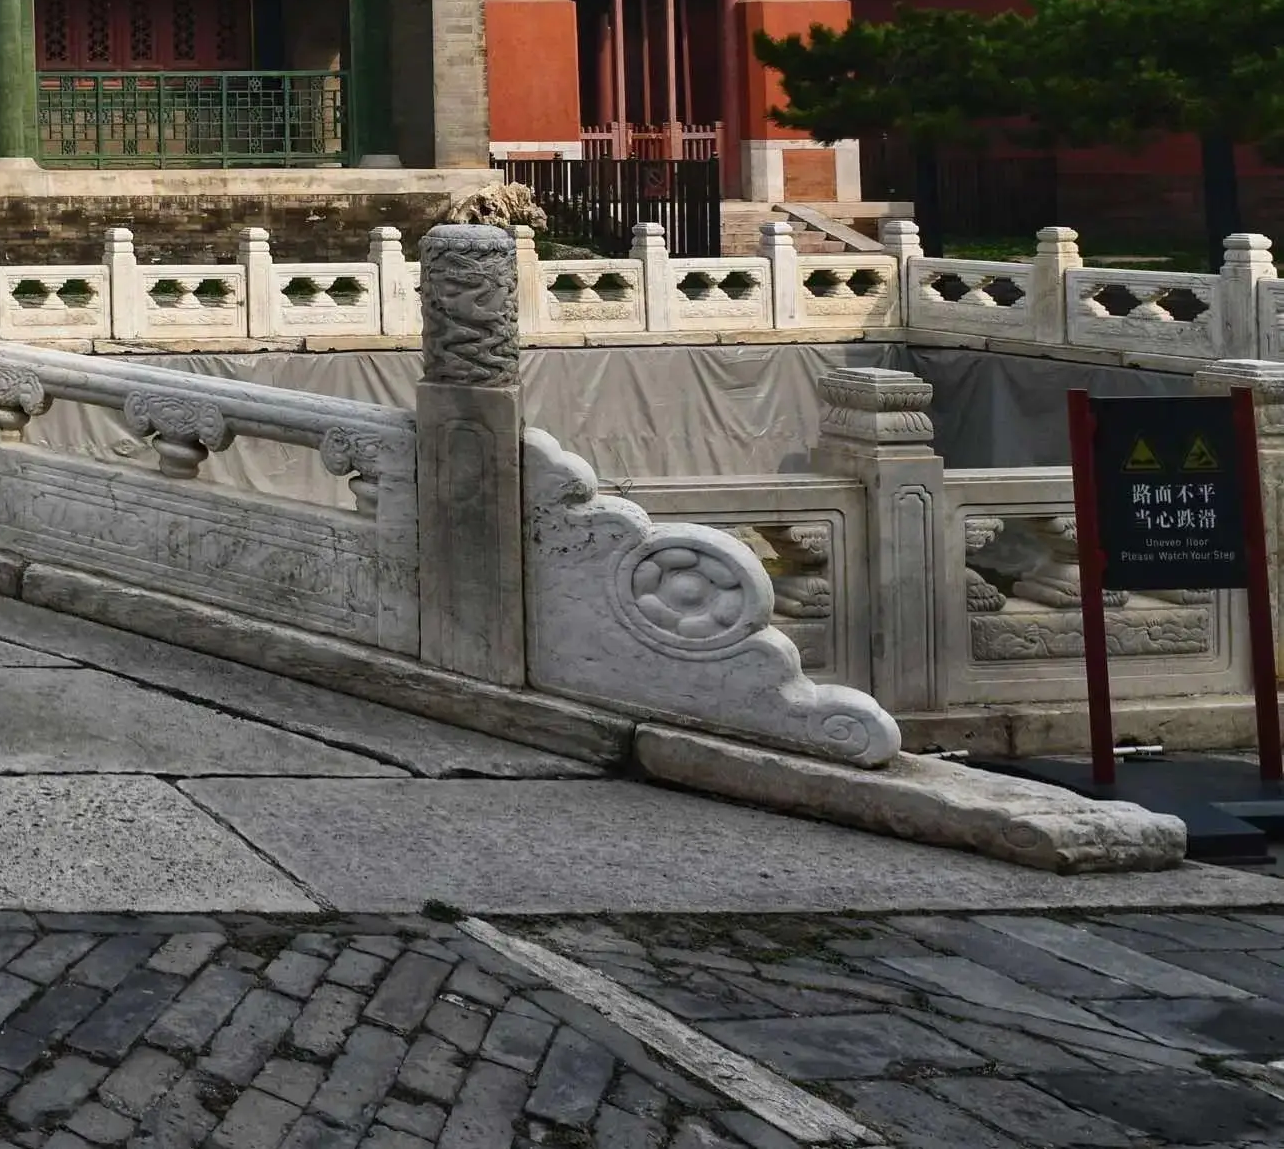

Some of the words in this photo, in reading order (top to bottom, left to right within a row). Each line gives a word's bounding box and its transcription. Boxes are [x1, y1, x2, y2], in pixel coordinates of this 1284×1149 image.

[1132, 483, 1216, 504] 路面不平
[1134, 508, 1217, 530] 当心跌滑
[1145, 538, 1182, 548] Uneven
[1121, 551, 1154, 561] Please
[1158, 551, 1188, 561] Watch
[1190, 550, 1211, 561] Your
[1213, 550, 1235, 561] Step
